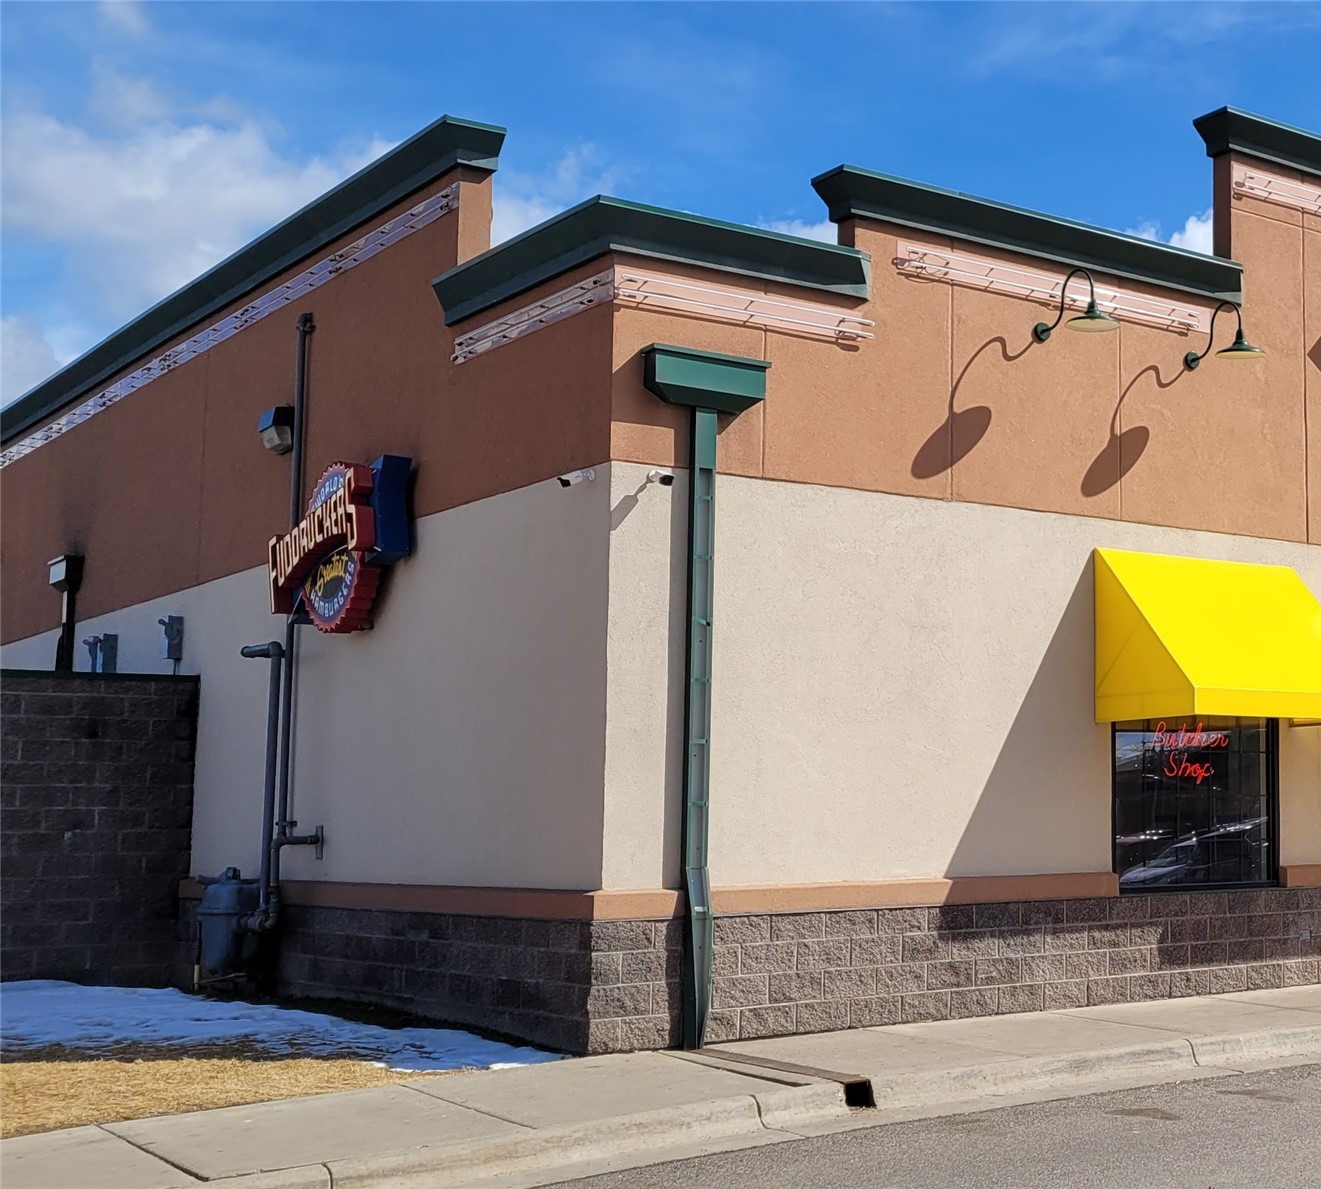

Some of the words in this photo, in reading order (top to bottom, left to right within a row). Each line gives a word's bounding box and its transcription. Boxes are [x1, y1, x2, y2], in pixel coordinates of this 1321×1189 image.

[268, 467, 356, 613] FUDDRUCKERS
[311, 562, 354, 617] HAMBURGERS
[315, 553, 349, 597] Greatest
[1151, 721, 1229, 748] Butcher
[1164, 751, 1214, 784] Shop
